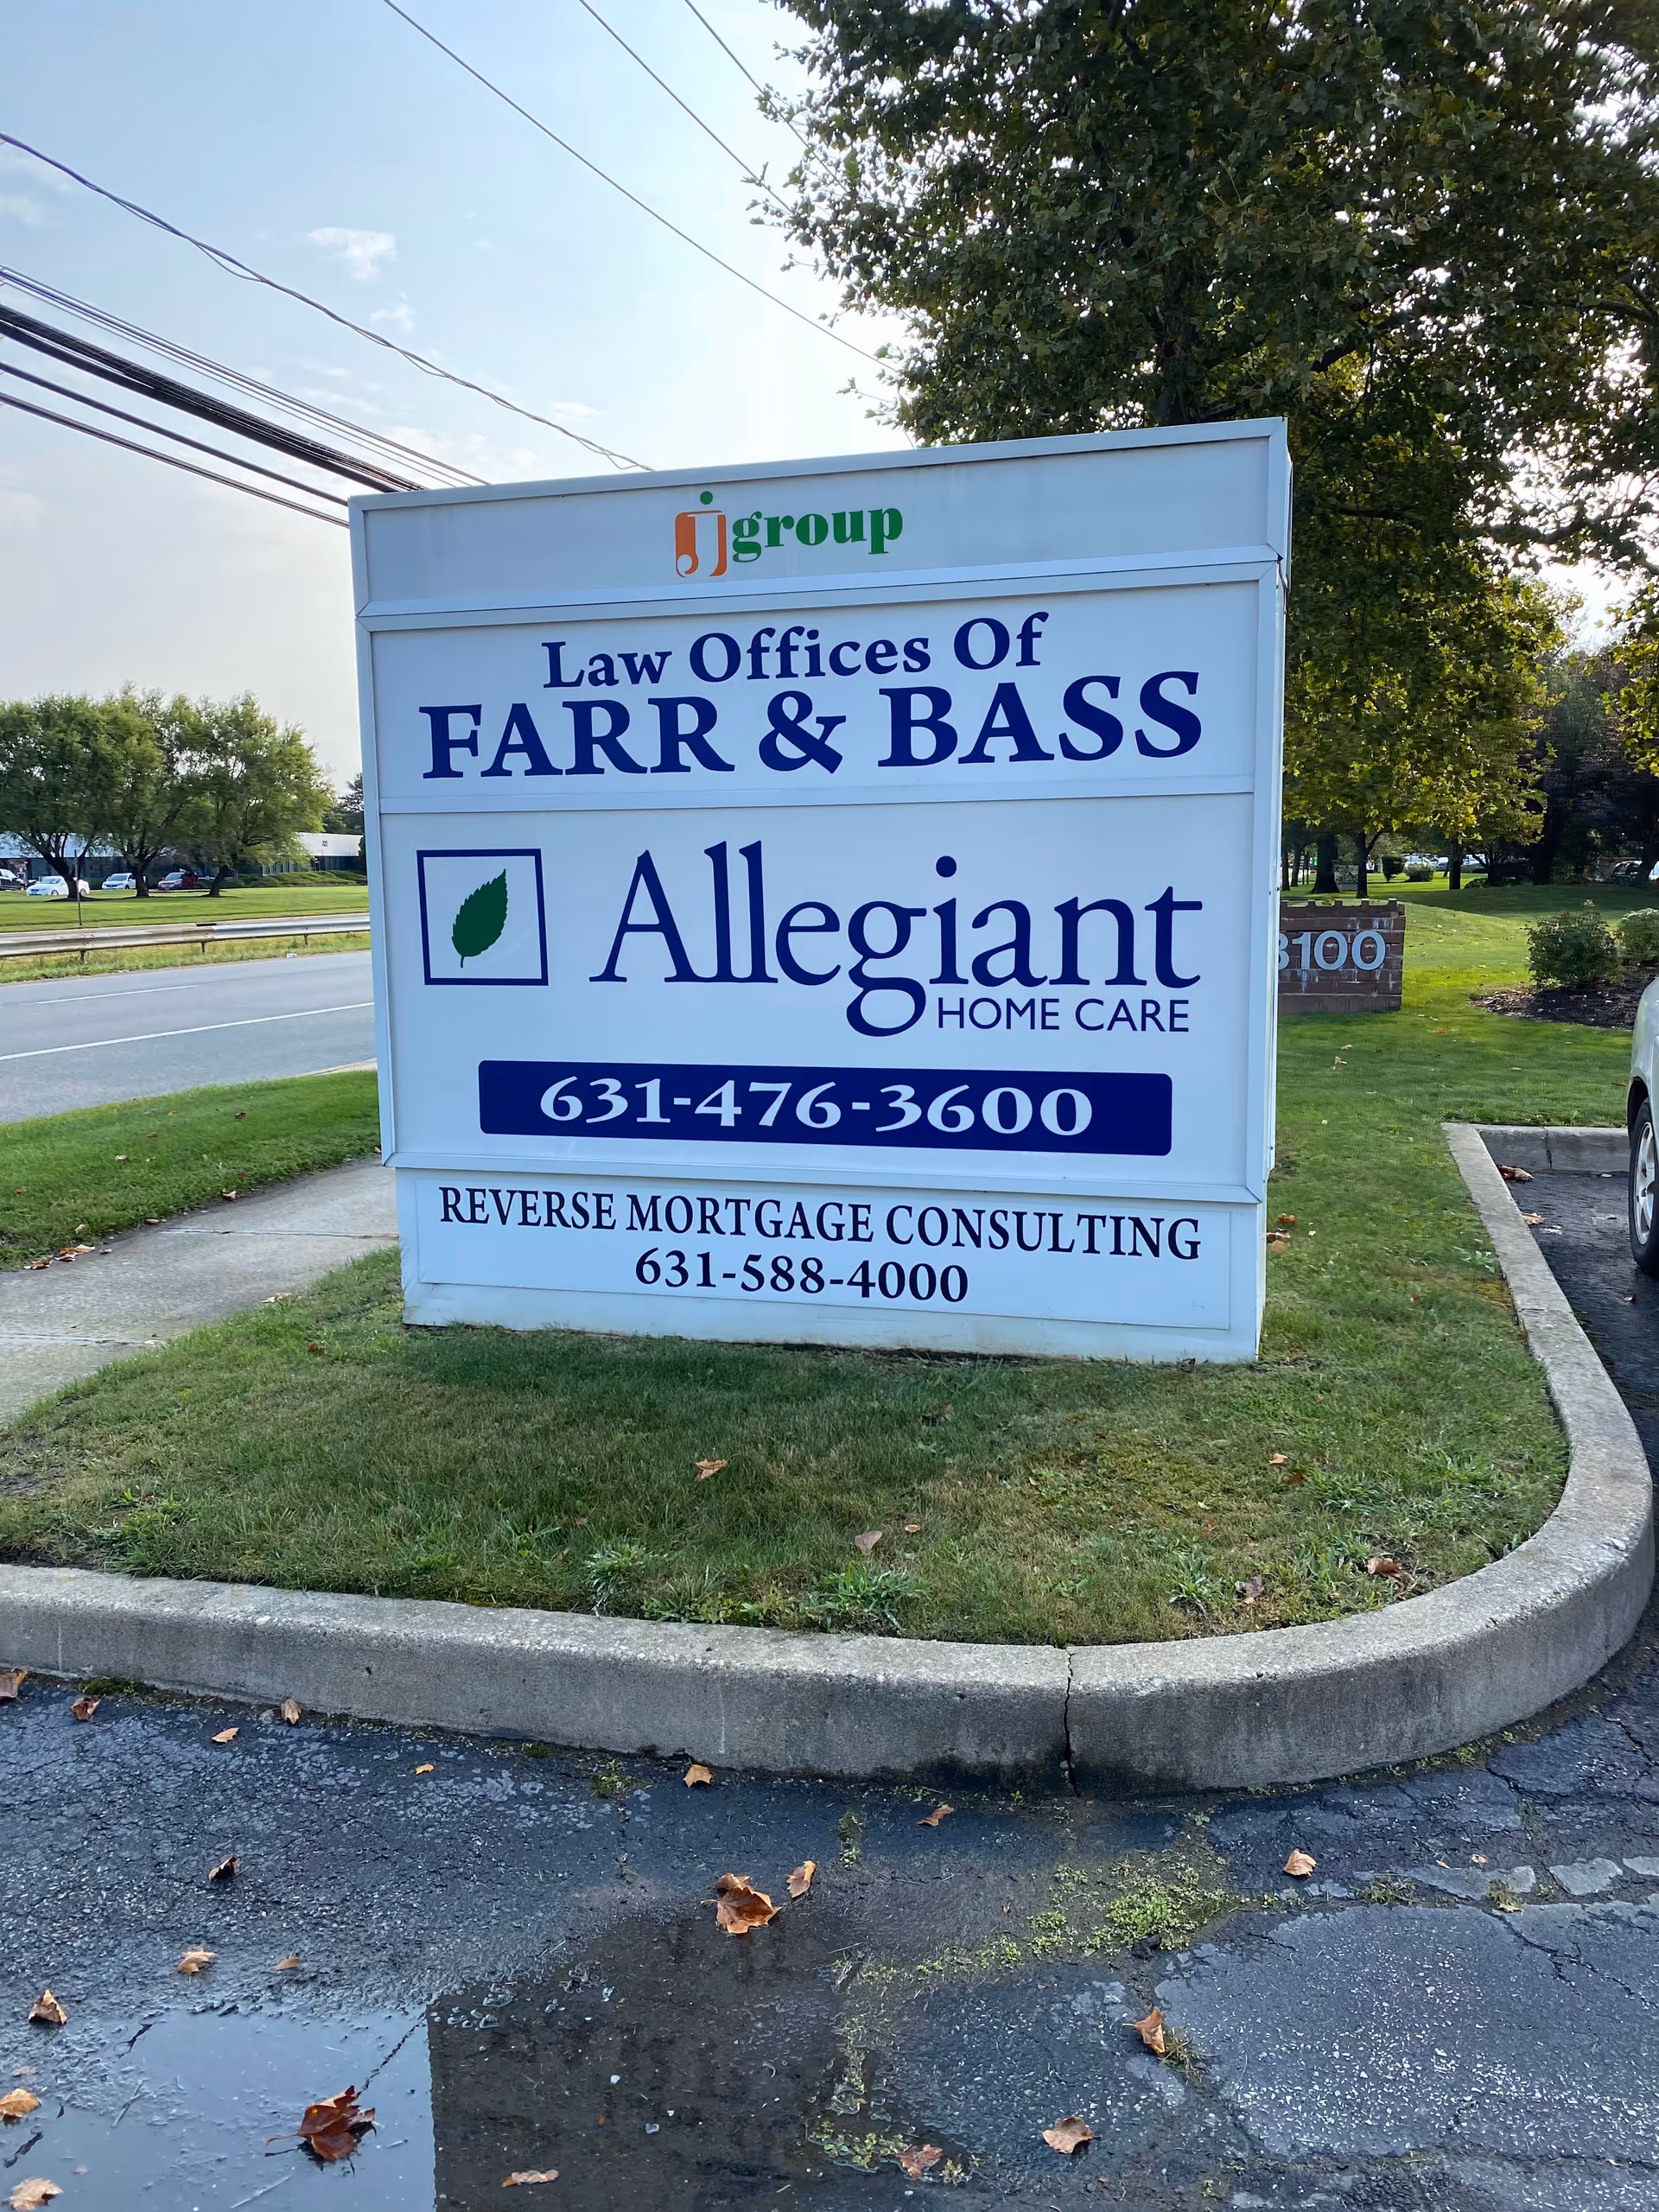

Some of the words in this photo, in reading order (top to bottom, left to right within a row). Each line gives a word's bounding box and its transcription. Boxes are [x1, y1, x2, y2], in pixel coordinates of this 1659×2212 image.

[542, 641, 672, 688] Law
[690, 626, 931, 682] Offices
[954, 612, 1049, 670] Of
[419, 696, 734, 779] FARR
[759, 690, 846, 773] &
[878, 671, 1202, 767] BASS
[589, 841, 1203, 1037] Allegiant
[938, 998, 1059, 1031] HOME
[1076, 999, 1189, 1032] CARE
[540, 1077, 1093, 1136] 631-476-3600
[439, 1187, 617, 1230] REVERSE
[626, 1194, 874, 1242] MORTGAGE
[887, 1205, 1200, 1260] CONSULTING
[636, 1248, 968, 1302] 631-588-4000
